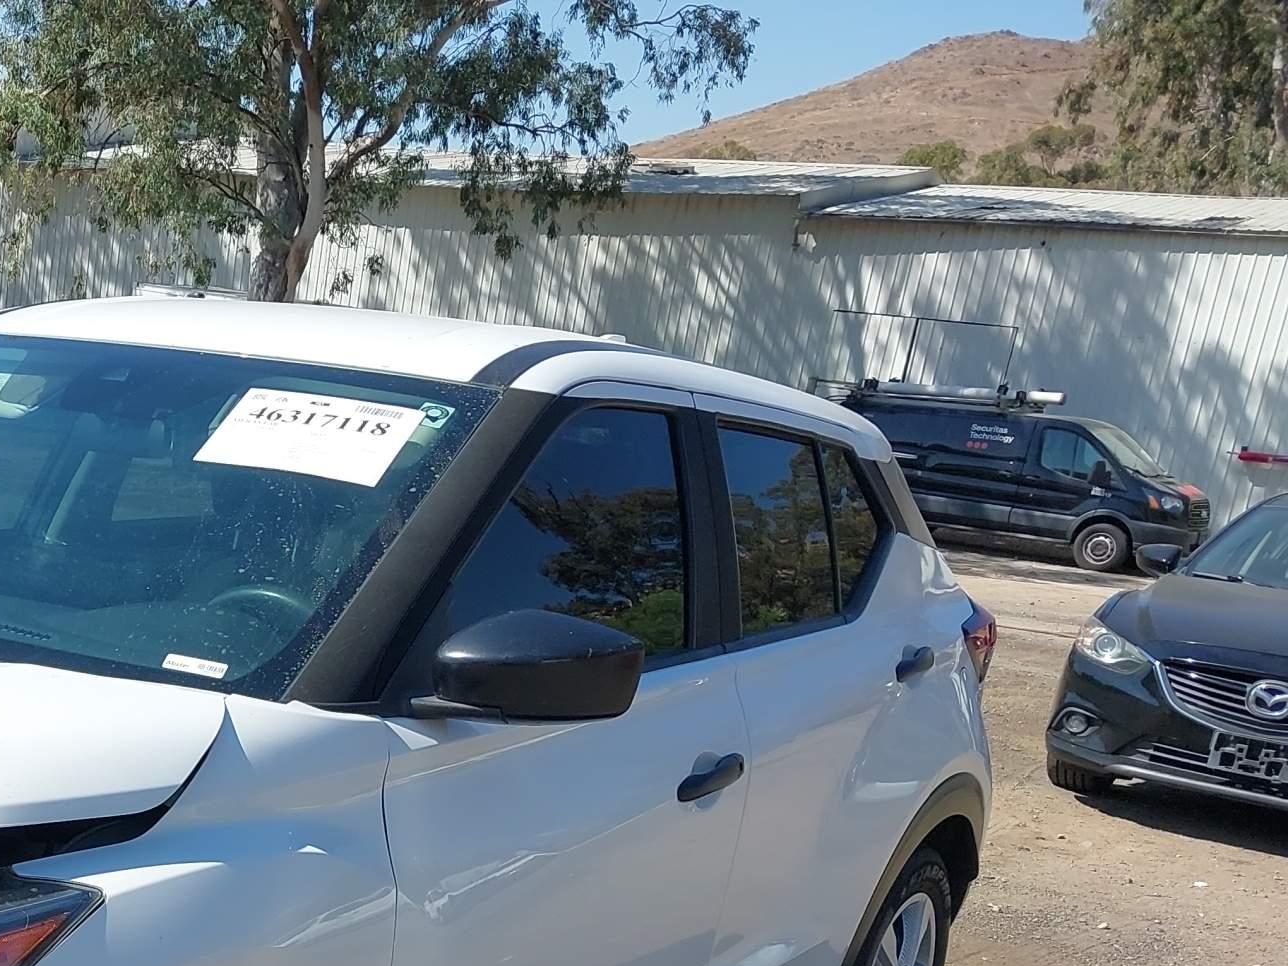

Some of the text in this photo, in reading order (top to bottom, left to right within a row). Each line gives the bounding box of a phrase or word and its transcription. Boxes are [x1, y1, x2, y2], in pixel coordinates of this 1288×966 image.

[249, 406, 391, 436] 46317118
[970, 423, 1008, 434] Securitas
[969, 430, 1014, 443] Technology
